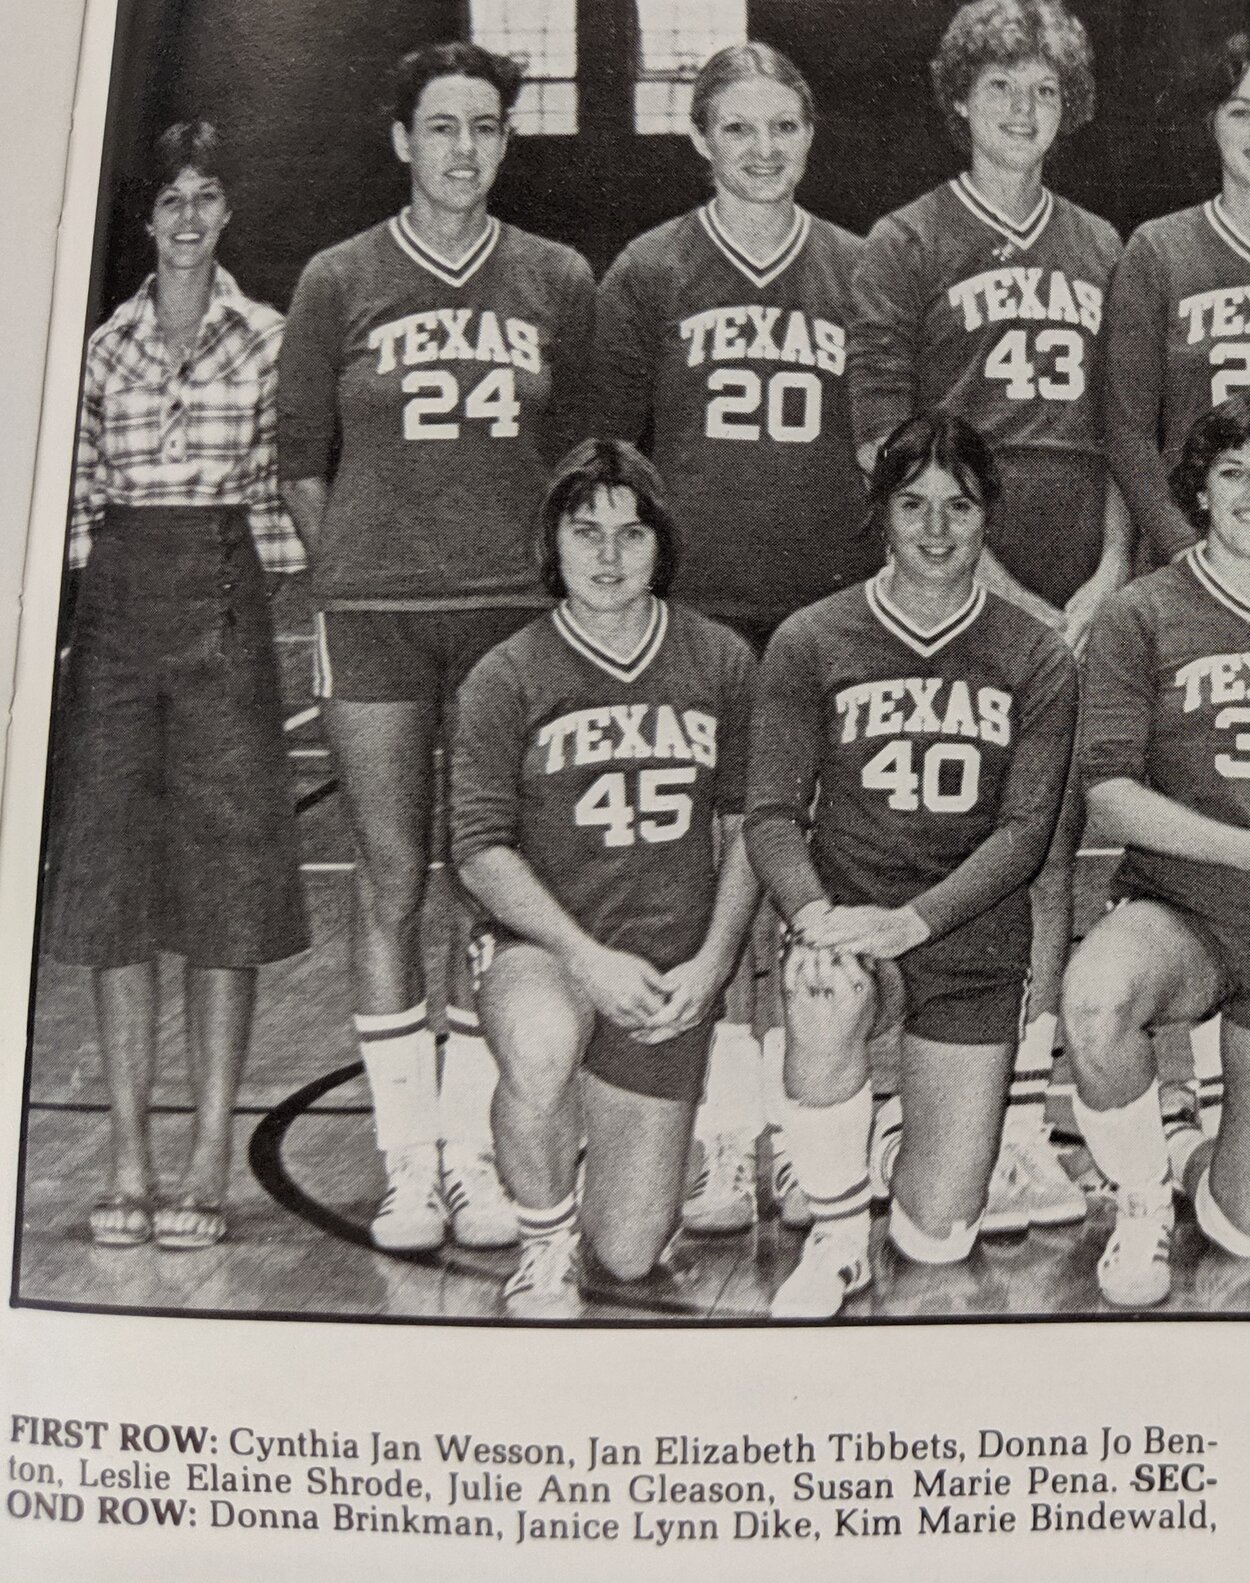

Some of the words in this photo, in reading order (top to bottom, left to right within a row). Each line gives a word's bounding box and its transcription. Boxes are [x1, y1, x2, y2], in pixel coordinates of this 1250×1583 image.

[945, 265, 1104, 336] TEXAS
[366, 307, 543, 375] TEXAS
[678, 304, 847, 376] TEXAS
[984, 329, 1086, 401] 43
[401, 368, 520, 440] 24
[705, 368, 822, 442] 20
[536, 702, 719, 776] TEXAS
[836, 676, 1014, 748] TEXAS
[574, 766, 698, 848] 45
[860, 740, 982, 814] 40
[11, 1415, 108, 1450] FIRST
[120, 1423, 217, 1454] ROW:
[229, 1428, 359, 1462] Cynthia
[371, 1432, 421, 1466] Jan
[435, 1434, 574, 1468] Wesson,
[588, 1437, 641, 1472] Jan
[655, 1433, 815, 1465] Elizabeth
[828, 1431, 965, 1462] Tibbets,
[979, 1430, 1087, 1458] Donna
[1101, 1427, 1131, 1462] Jo
[1144, 1426, 1217, 1454] Ben-
[8, 1455, 63, 1487] ton,
[80, 1459, 170, 1490] Leslie
[187, 1463, 291, 1493] Elaine
[307, 1467, 431, 1502] Shrode,
[448, 1472, 522, 1506] Julie
[538, 1475, 610, 1503] Ann
[629, 1474, 774, 1505] Gleason,
[794, 1472, 893, 1501] Susan
[914, 1469, 1010, 1498] Marie
[1028, 1466, 1117, 1495] Pena.
[1133, 1464, 1217, 1492] SEC-
[6, 1490, 84, 1523] OND
[98, 1497, 196, 1526] ROW:
[211, 1500, 319, 1530] Donna
[333, 1500, 502, 1540] Brinkman,
[516, 1510, 619, 1544] Janice
[633, 1512, 718, 1547] Lynn
[734, 1509, 820, 1541] Dike,
[835, 1509, 901, 1537] Kim
[919, 1505, 1015, 1534] Marie
[1031, 1500, 1216, 1532] Bindewald,
